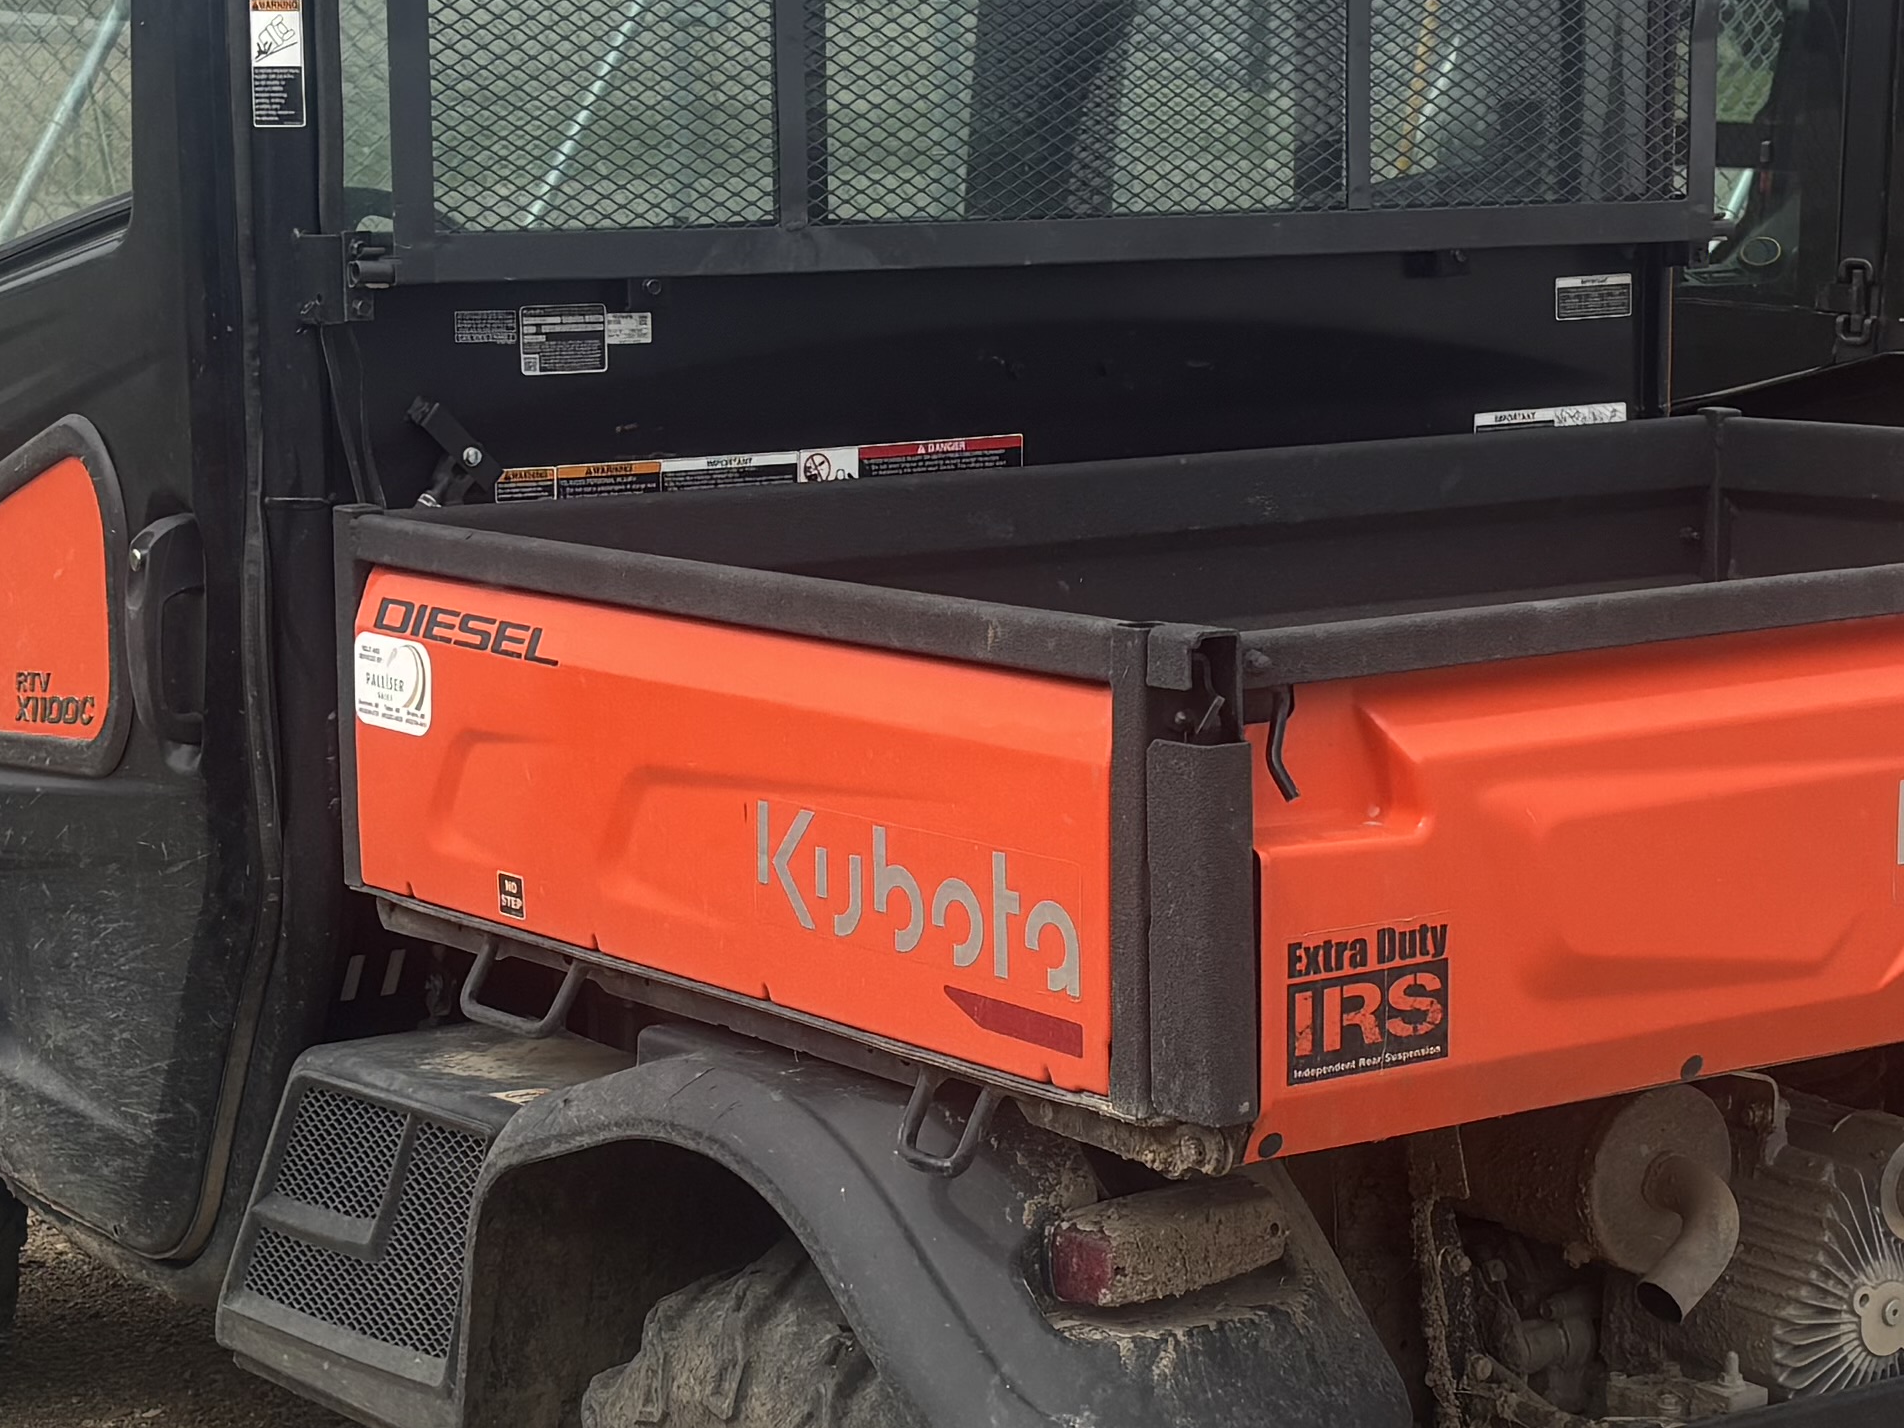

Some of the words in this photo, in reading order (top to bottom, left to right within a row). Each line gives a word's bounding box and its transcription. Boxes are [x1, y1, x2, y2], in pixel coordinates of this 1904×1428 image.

[259, 0, 298, 12] WARNING
[927, 441, 966, 454] DANGER
[374, 597, 559, 666] DIESEL
[16, 671, 51, 693] RTV
[366, 672, 404, 692] PALLISER
[505, 879, 517, 894] NO
[501, 894, 523, 910] STEP
[757, 800, 1081, 997] Kubota
[1288, 938, 1368, 979] Extra
[1377, 924, 1448, 965] Duty
[1295, 972, 1442, 1057] IRS
[1293, 1059, 1356, 1079] Independent
[1358, 1055, 1382, 1067] Rear
[1385, 1045, 1441, 1062] Suspension
